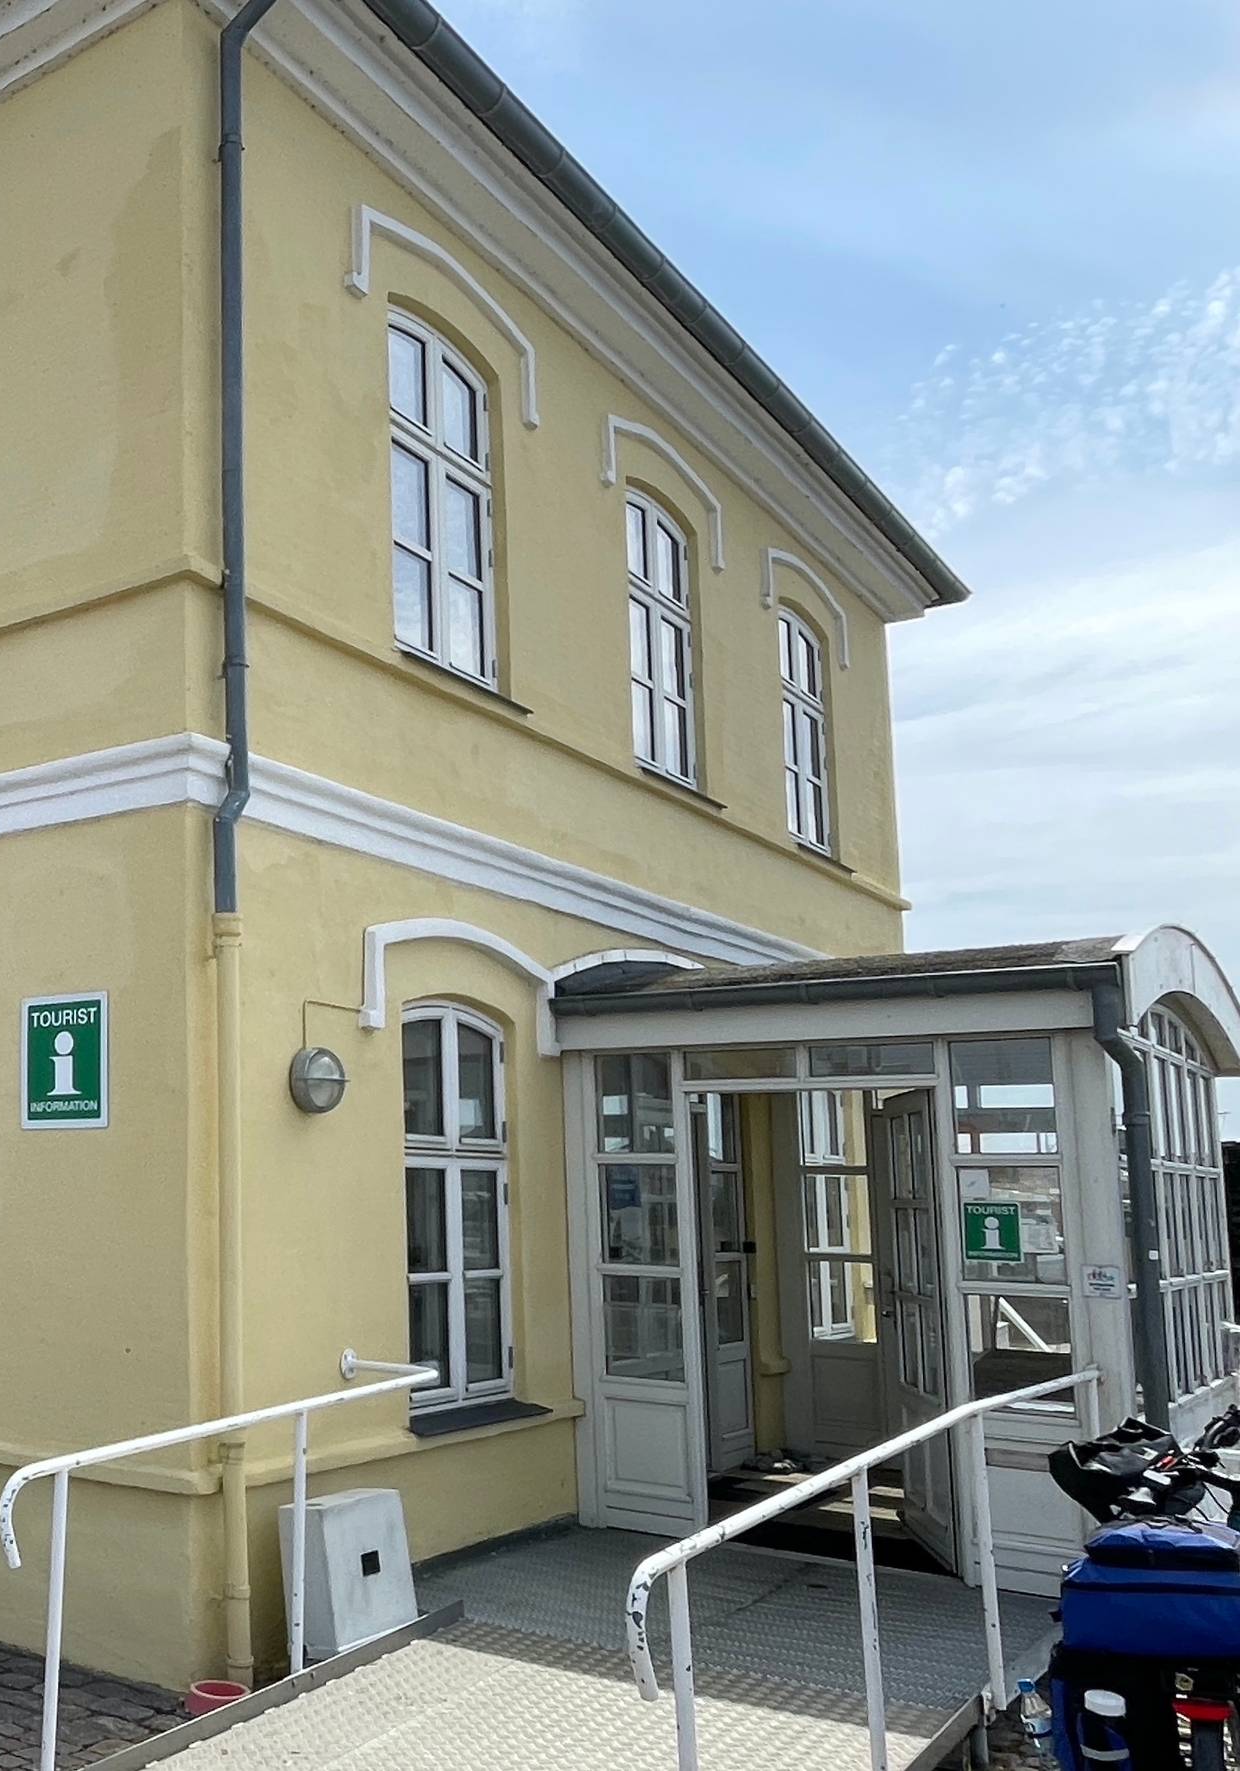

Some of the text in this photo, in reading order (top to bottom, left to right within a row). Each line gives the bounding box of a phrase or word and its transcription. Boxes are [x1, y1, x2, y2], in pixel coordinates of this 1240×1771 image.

[31, 1008, 98, 1028] TOURIST
[30, 1100, 98, 1112] INFORMATION
[966, 1205, 1016, 1215] TOURIST
